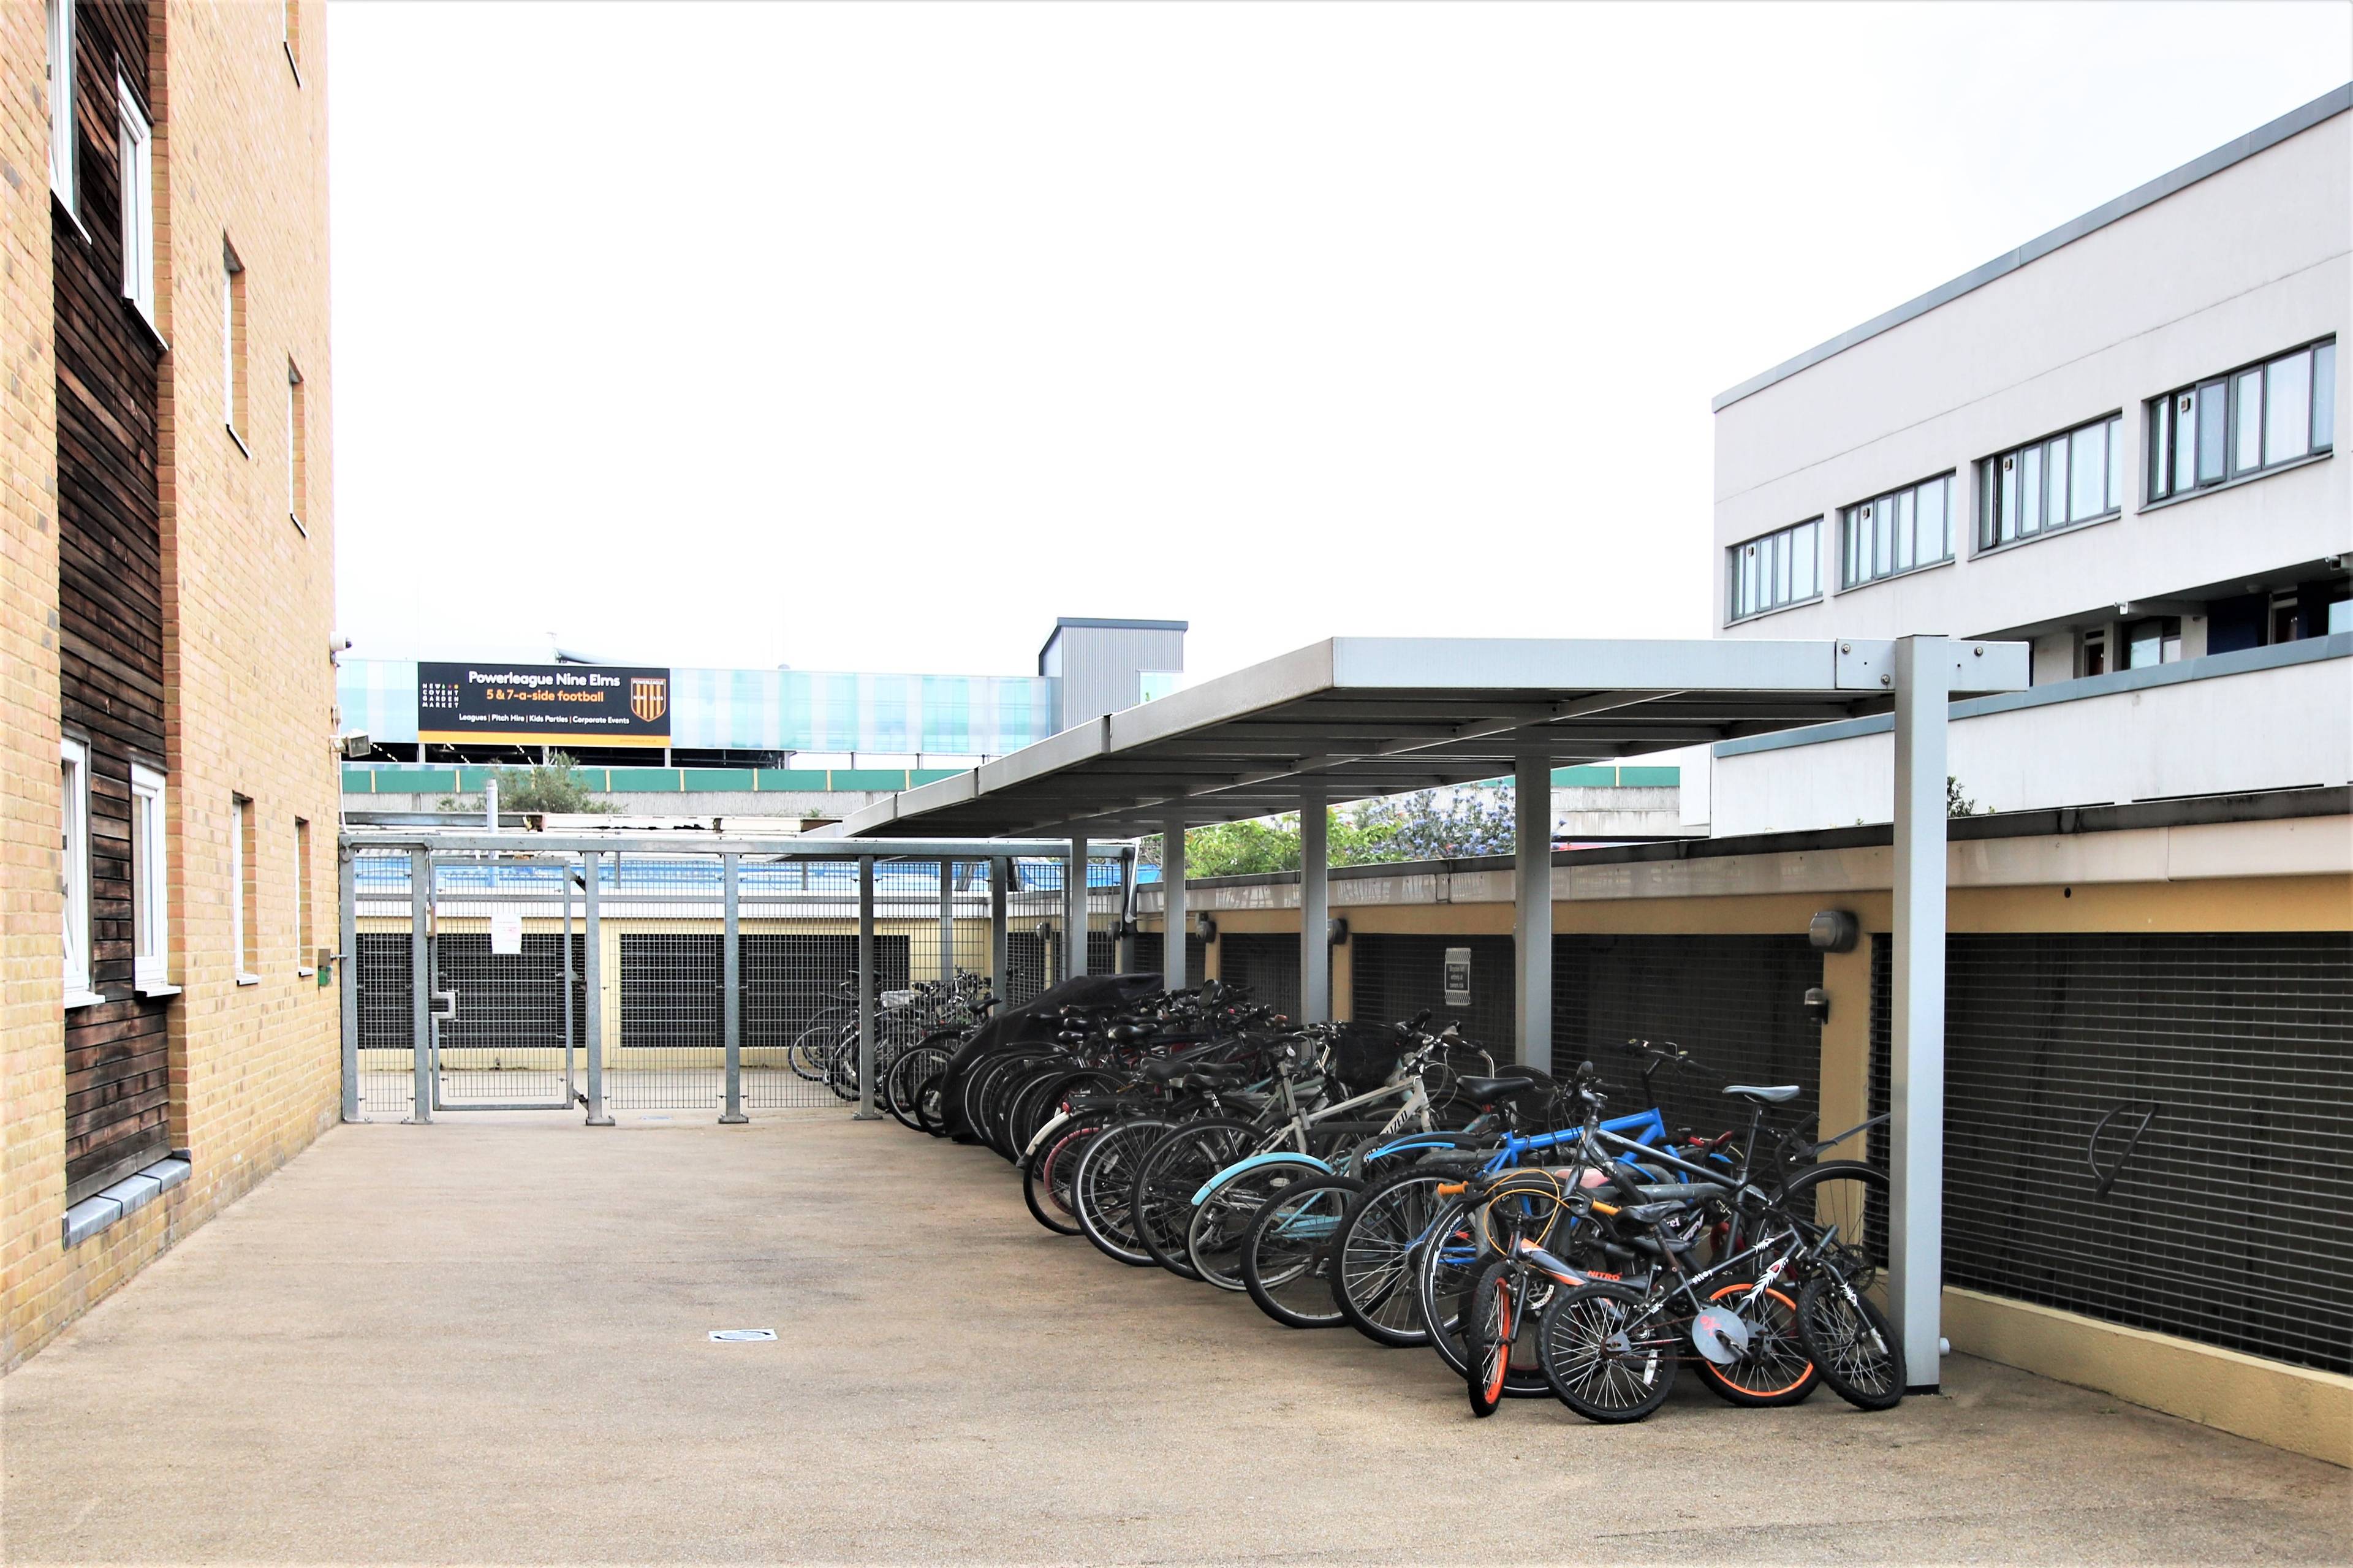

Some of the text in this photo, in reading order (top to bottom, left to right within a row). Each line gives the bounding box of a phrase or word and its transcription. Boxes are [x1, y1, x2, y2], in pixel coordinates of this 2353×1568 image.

[469, 671, 620, 687] Powerleague Nine Elms
[487, 689, 604, 702] 5 & 7-a-side football
[459, 714, 487, 722] Leagues
[572, 716, 607, 724] Corporate
[1588, 1270, 1620, 1281] NITRO
